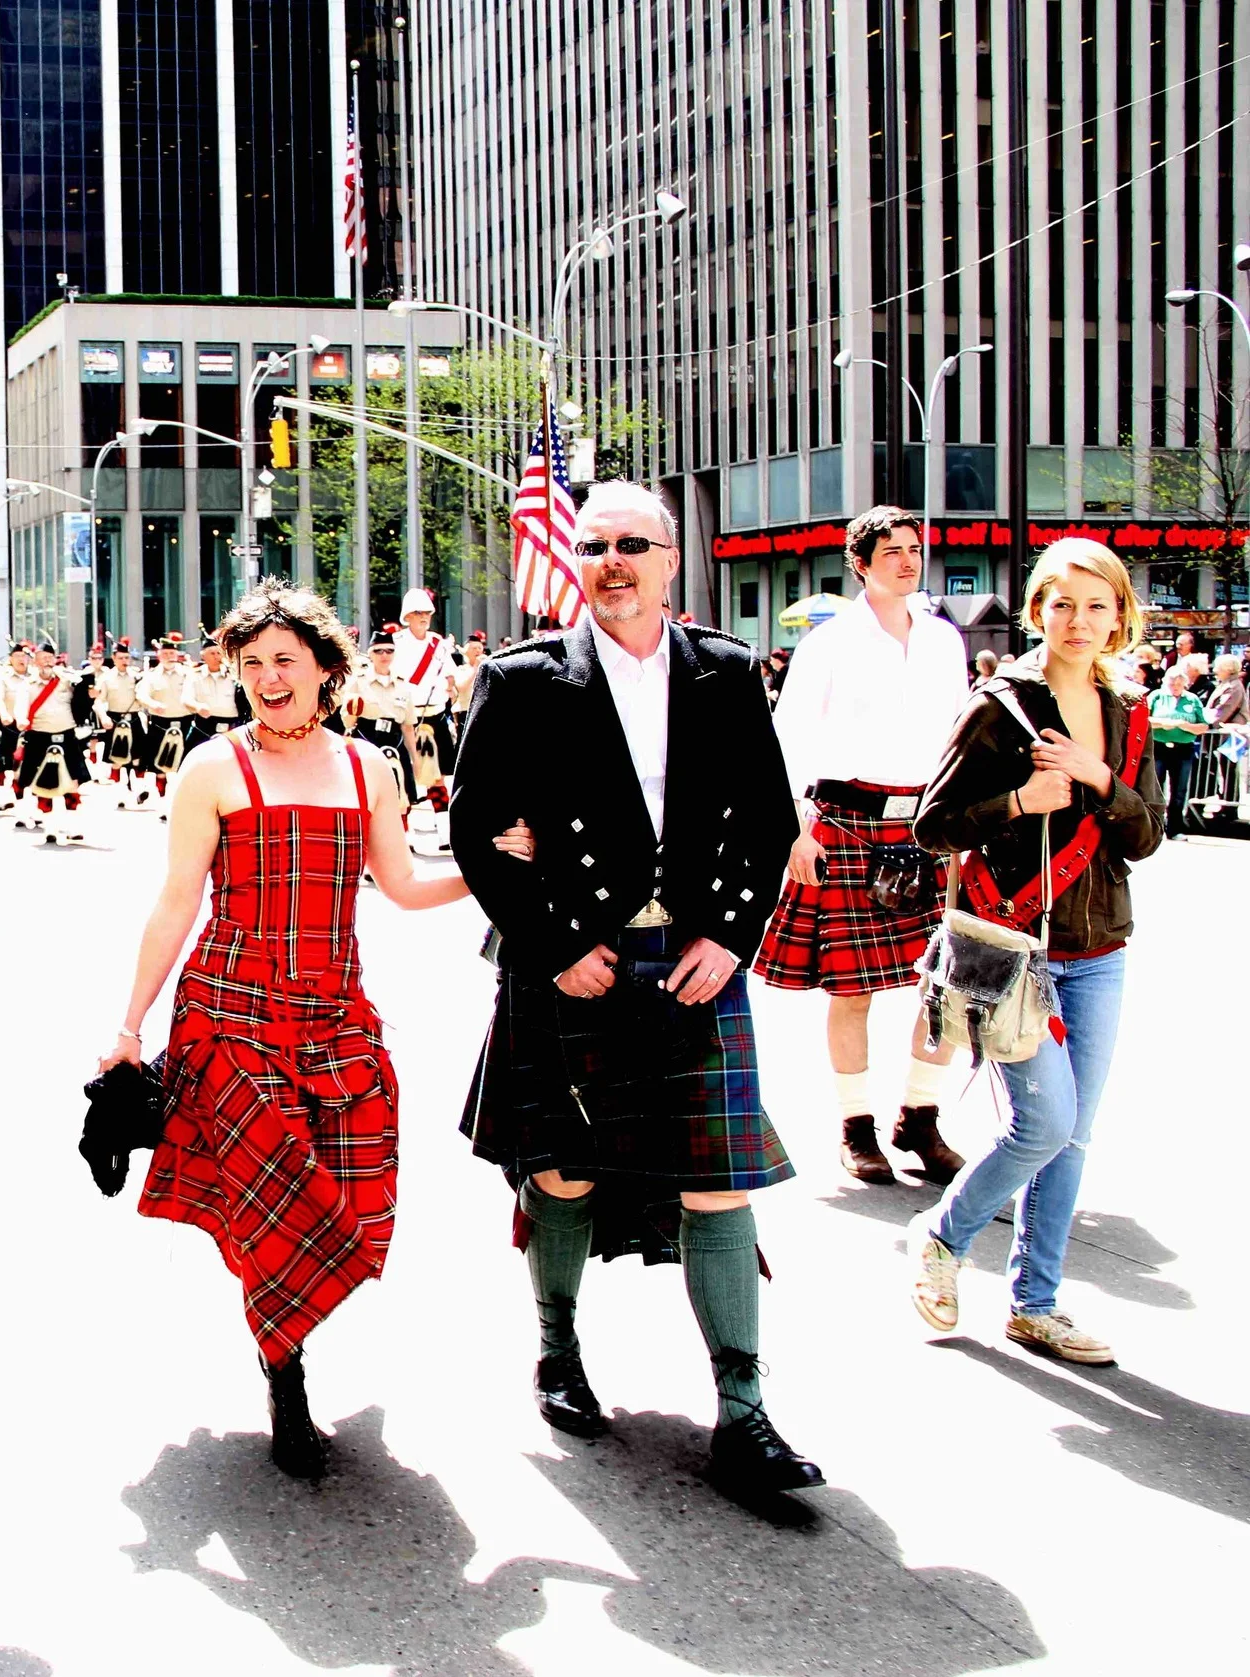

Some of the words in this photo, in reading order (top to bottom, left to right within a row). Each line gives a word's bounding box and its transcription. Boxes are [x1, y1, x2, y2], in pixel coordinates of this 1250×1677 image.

[713, 532, 771, 558] California
[946, 522, 988, 546] self
[1028, 523, 1111, 547] houlder
[1114, 523, 1163, 547] after
